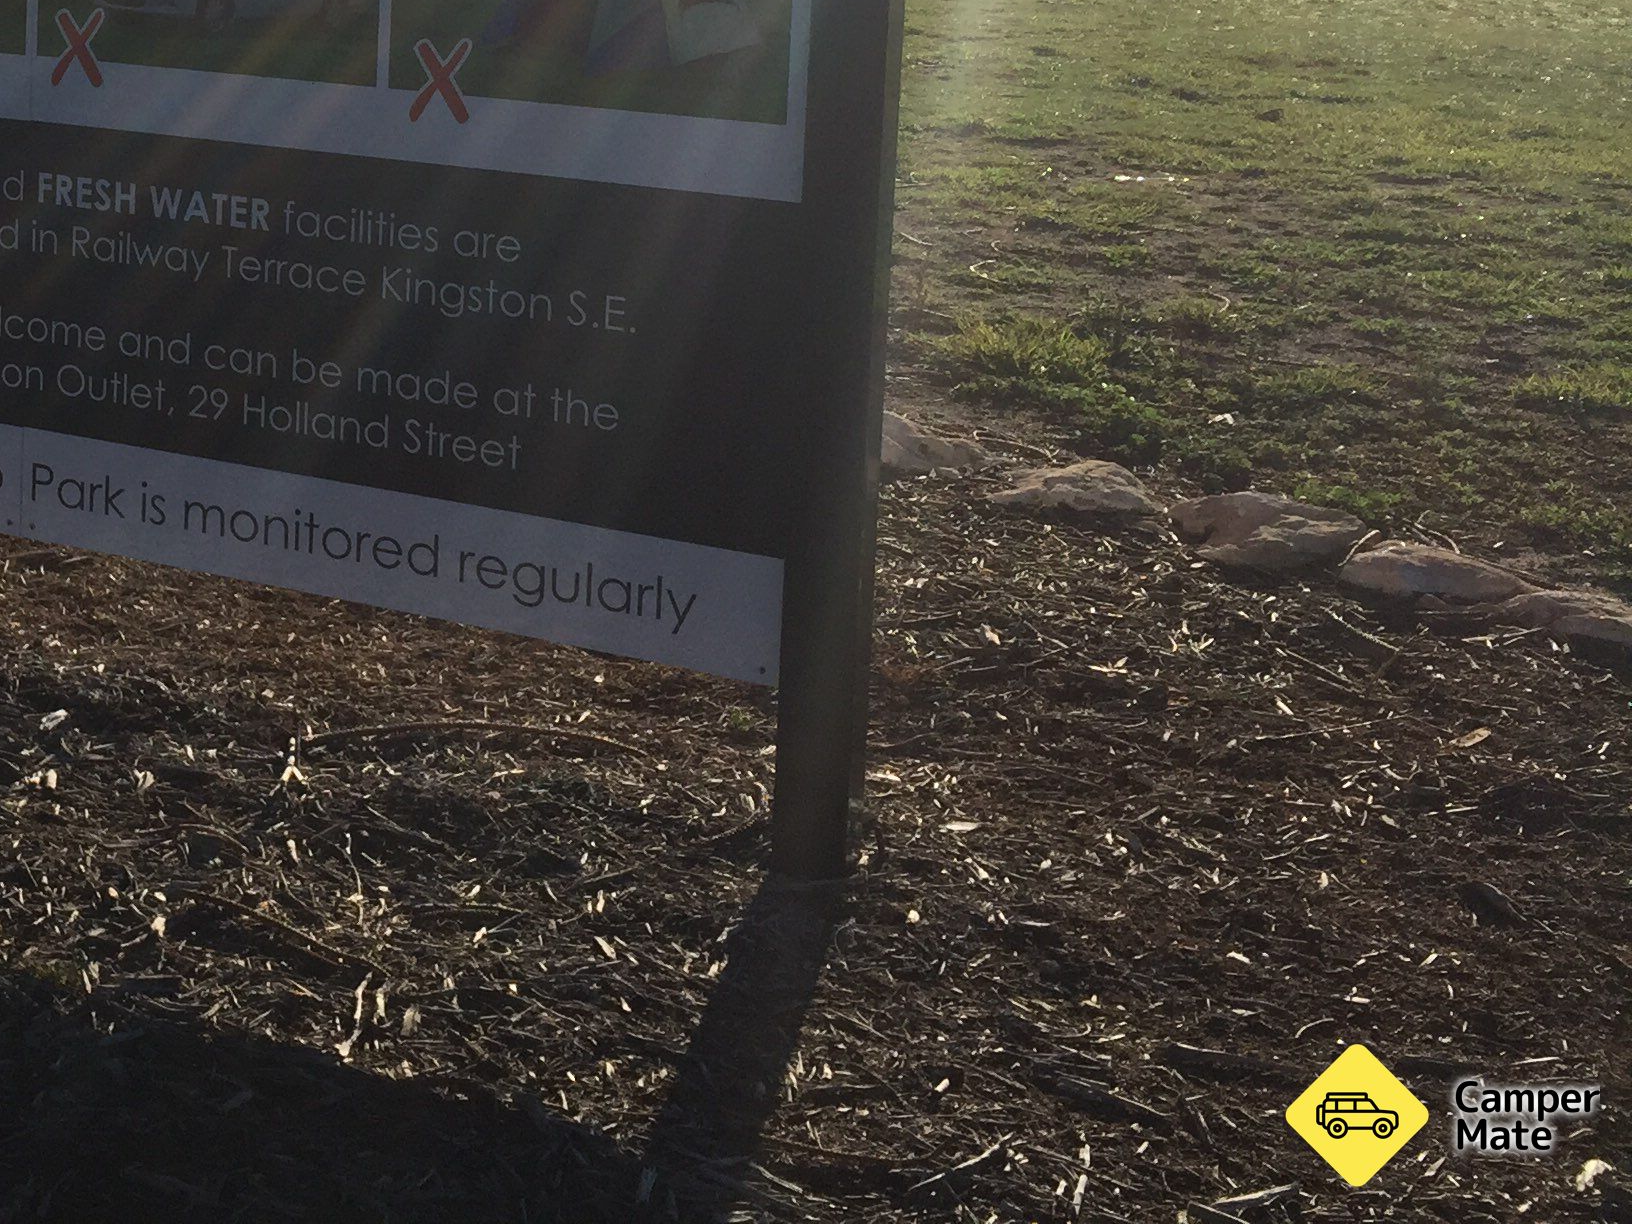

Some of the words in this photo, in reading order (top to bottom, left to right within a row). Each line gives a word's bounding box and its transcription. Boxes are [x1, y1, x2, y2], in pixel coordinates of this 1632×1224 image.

[38, 172, 136, 216] FRESH
[150, 184, 270, 232] WATER
[283, 200, 438, 252] facilities
[453, 229, 521, 263] are
[31, 219, 57, 255] in
[72, 225, 209, 281] Railway
[221, 245, 367, 296] Terrace
[381, 265, 552, 321] Kingston
[567, 290, 636, 333] S.E.
[57, 364, 173, 415] Outlet,
[188, 384, 229, 420] 29
[243, 393, 390, 449] Holland
[403, 418, 521, 470] Street
[119, 329, 191, 364] and
[204, 343, 276, 378] can
[293, 349, 341, 387] be
[356, 366, 478, 409] made
[493, 384, 536, 418] at
[550, 387, 619, 430] the
[31, 463, 126, 519] Park
[140, 481, 166, 525] is
[184, 501, 439, 577] monitored
[459, 550, 696, 634] regularly
